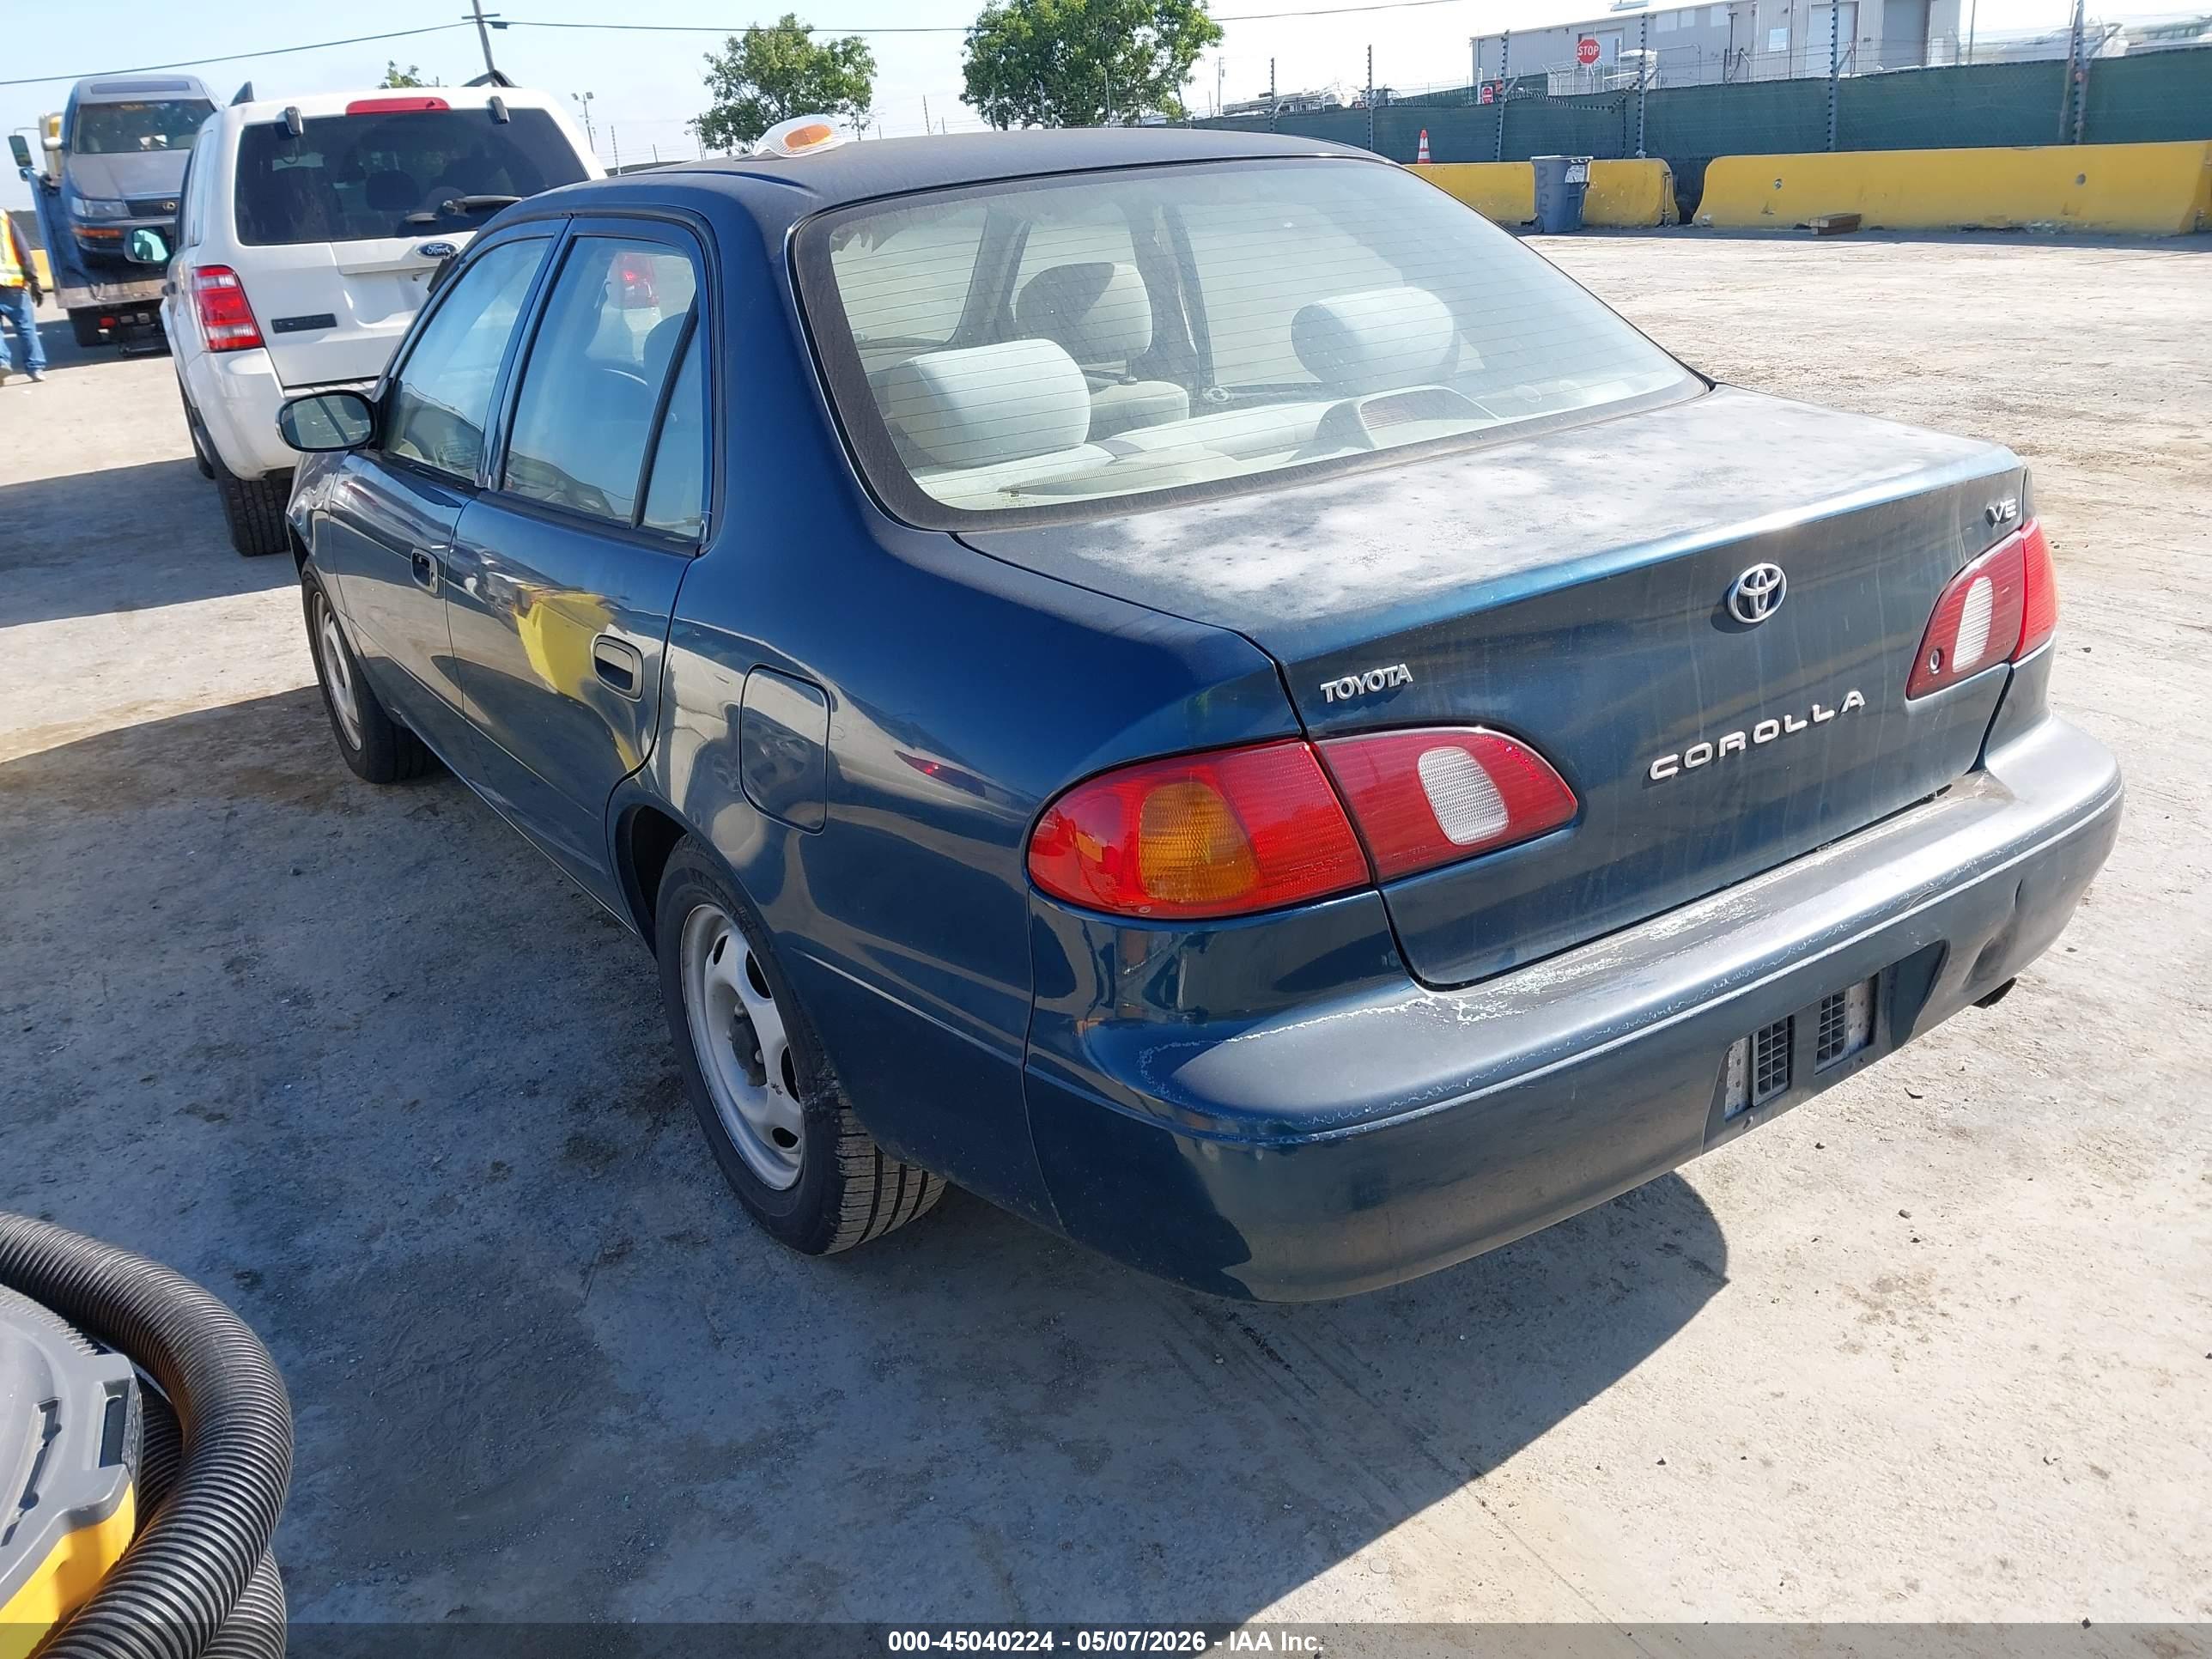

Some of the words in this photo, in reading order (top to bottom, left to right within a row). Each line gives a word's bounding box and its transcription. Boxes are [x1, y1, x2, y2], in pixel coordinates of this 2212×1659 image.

[1577, 45, 1599, 56] STOP
[426, 244, 451, 255] Ford
[1988, 498, 2017, 522] VE
[1320, 663, 1414, 703] TOYOTA
[1649, 690, 1866, 781] COROLLA
